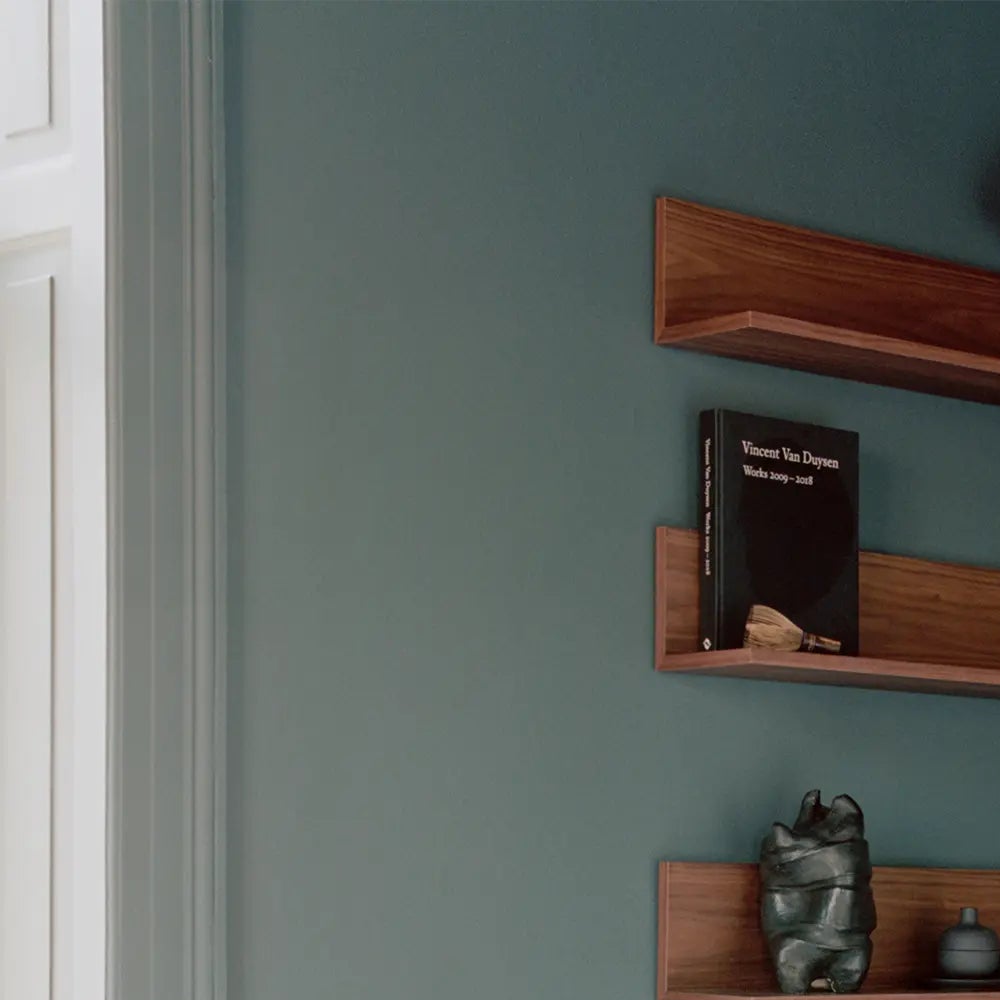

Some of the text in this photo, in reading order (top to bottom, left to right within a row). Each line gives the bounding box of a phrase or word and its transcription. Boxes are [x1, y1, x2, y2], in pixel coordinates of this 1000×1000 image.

[742, 440, 839, 470] Vincent Van Duysen
[743, 464, 768, 480] Works
[769, 472, 788, 484] 2009
[795, 474, 814, 486] 2018
